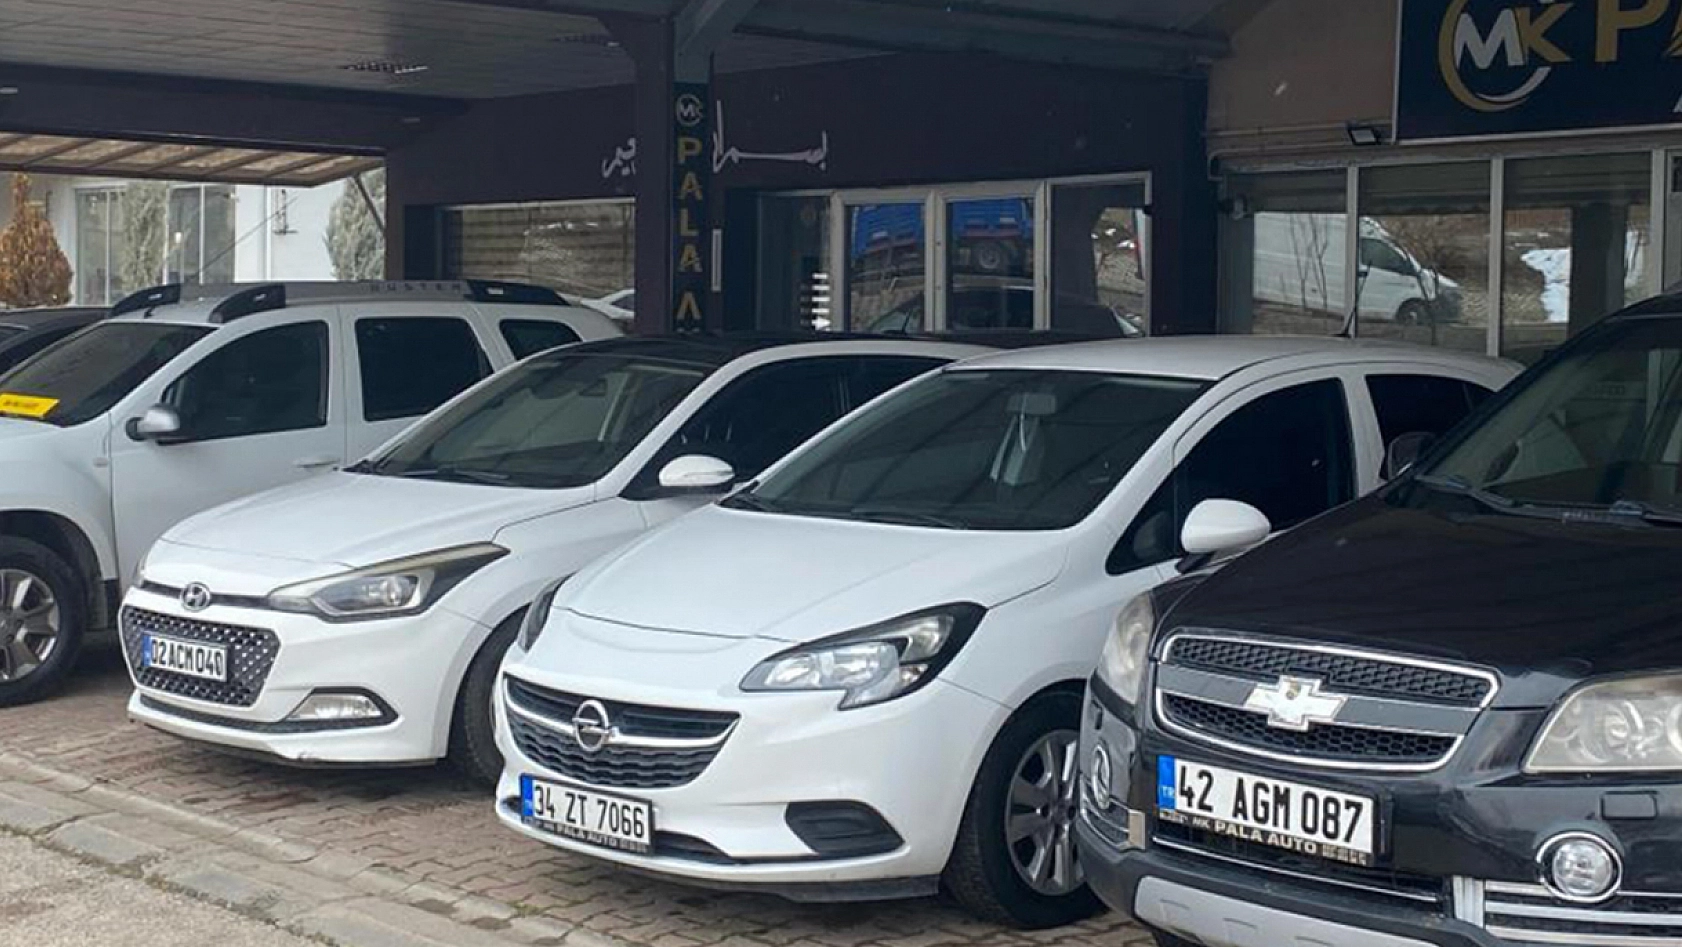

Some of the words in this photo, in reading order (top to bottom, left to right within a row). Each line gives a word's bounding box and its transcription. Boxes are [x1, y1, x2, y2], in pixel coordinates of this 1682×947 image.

[1594, 0, 1682, 62] P
[676, 137, 703, 273] PALA
[534, 784, 555, 819] 34
[565, 791, 588, 826] ZT
[597, 798, 645, 839] 7066
[1178, 765, 1214, 813] 42
[1231, 777, 1291, 831] AGM
[1300, 790, 1364, 843] 087
[556, 823, 585, 840] PALA
[587, 831, 617, 847] AUTO
[1214, 820, 1263, 843] PALA
[1267, 832, 1317, 854] AUTO
